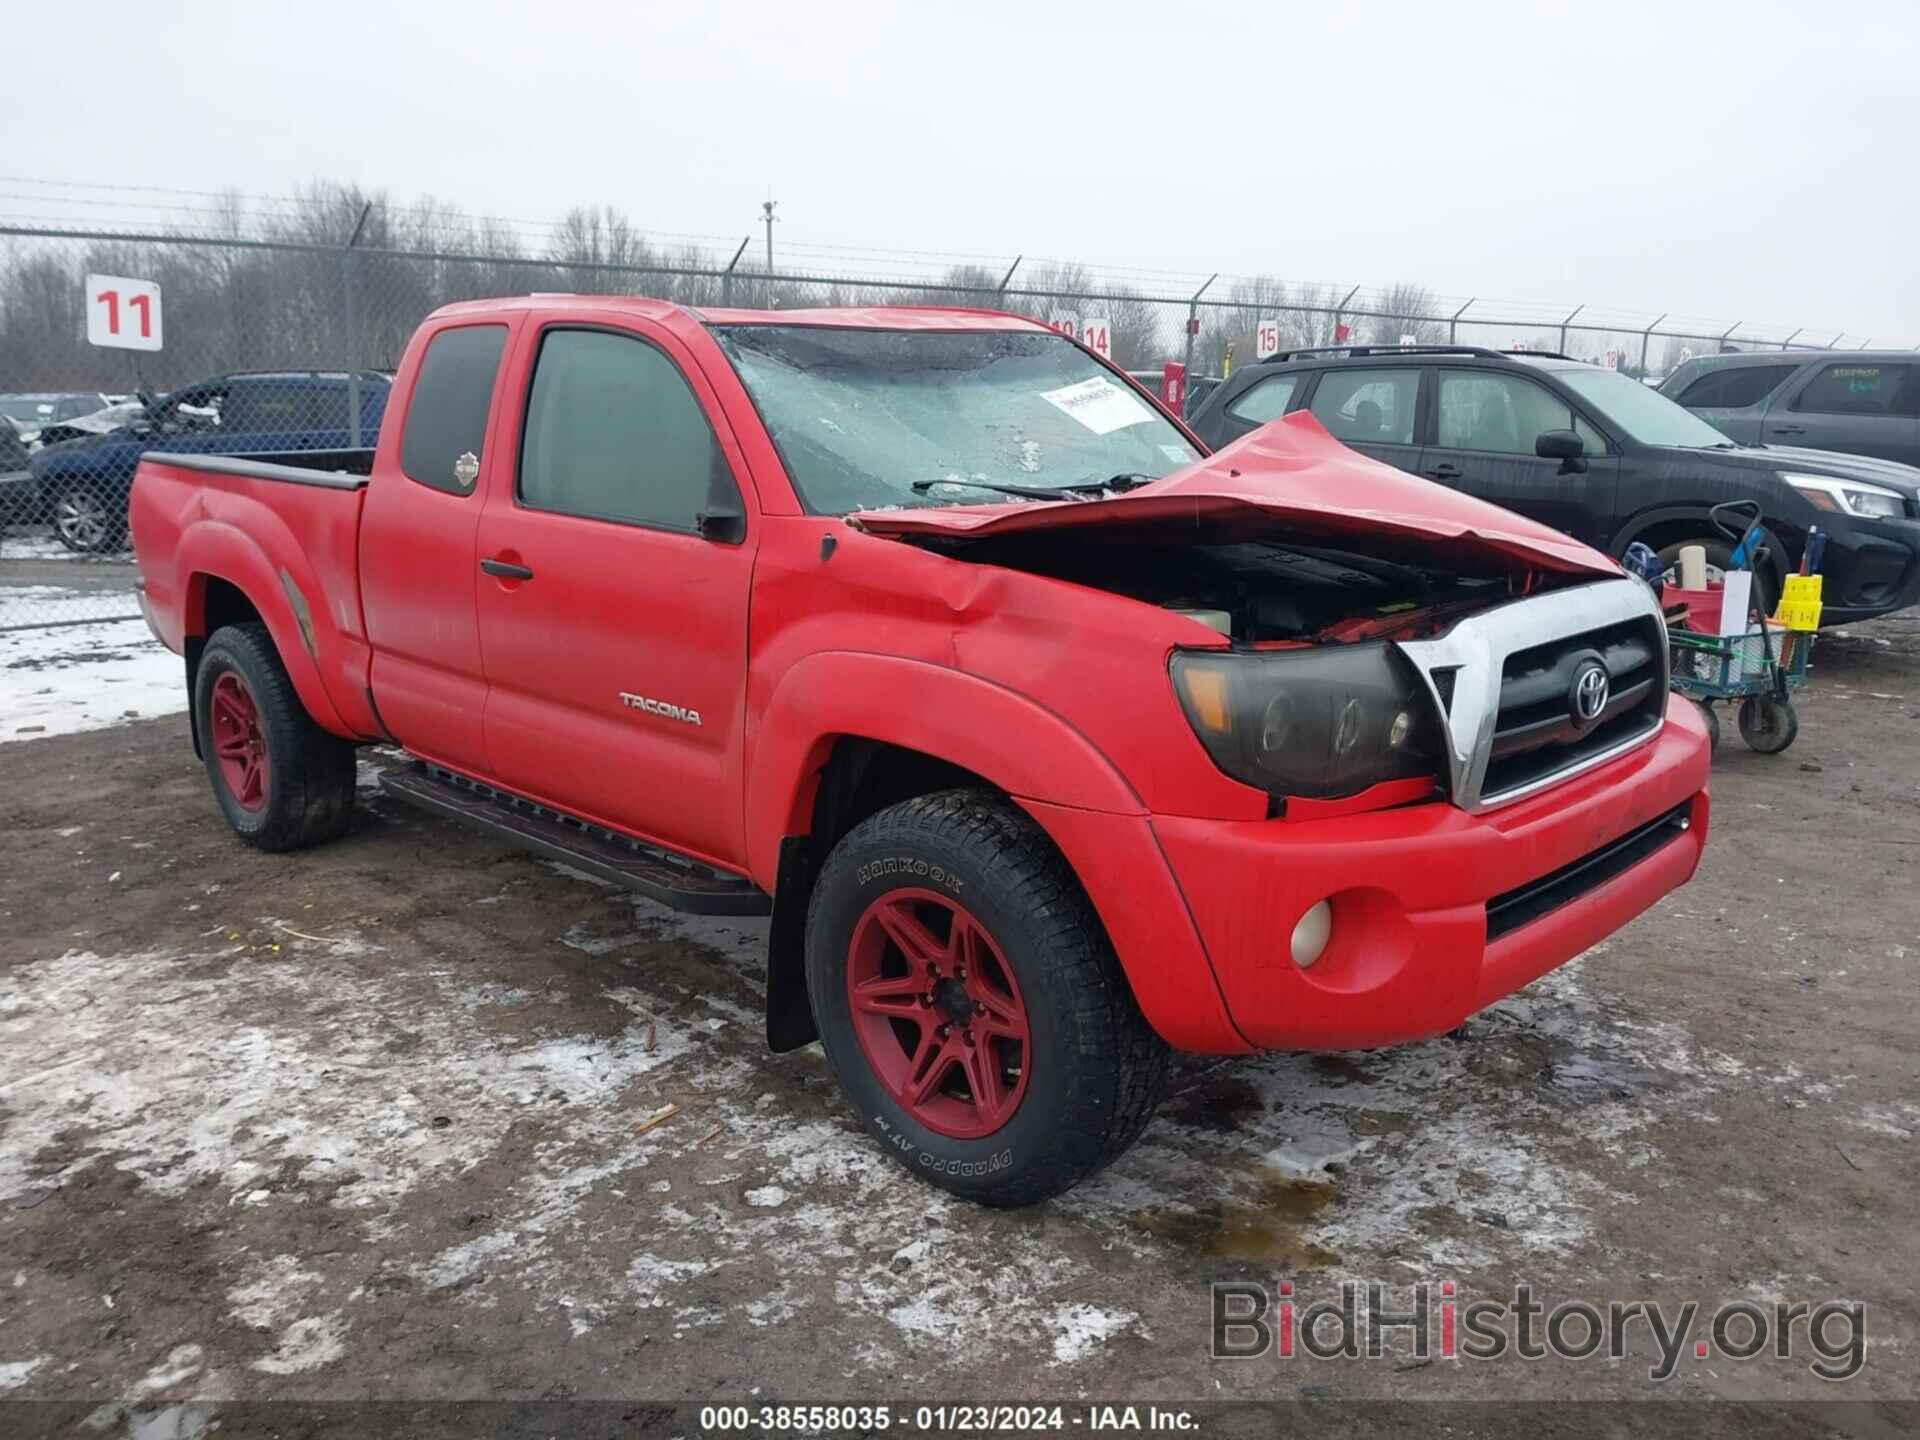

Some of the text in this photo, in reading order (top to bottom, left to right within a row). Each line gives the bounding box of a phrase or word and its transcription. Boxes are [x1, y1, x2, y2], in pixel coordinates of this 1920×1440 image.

[97, 290, 150, 338] 11
[1086, 327, 1108, 354] 14
[1259, 327, 1276, 351] 15
[619, 691, 702, 725] TACOMA
